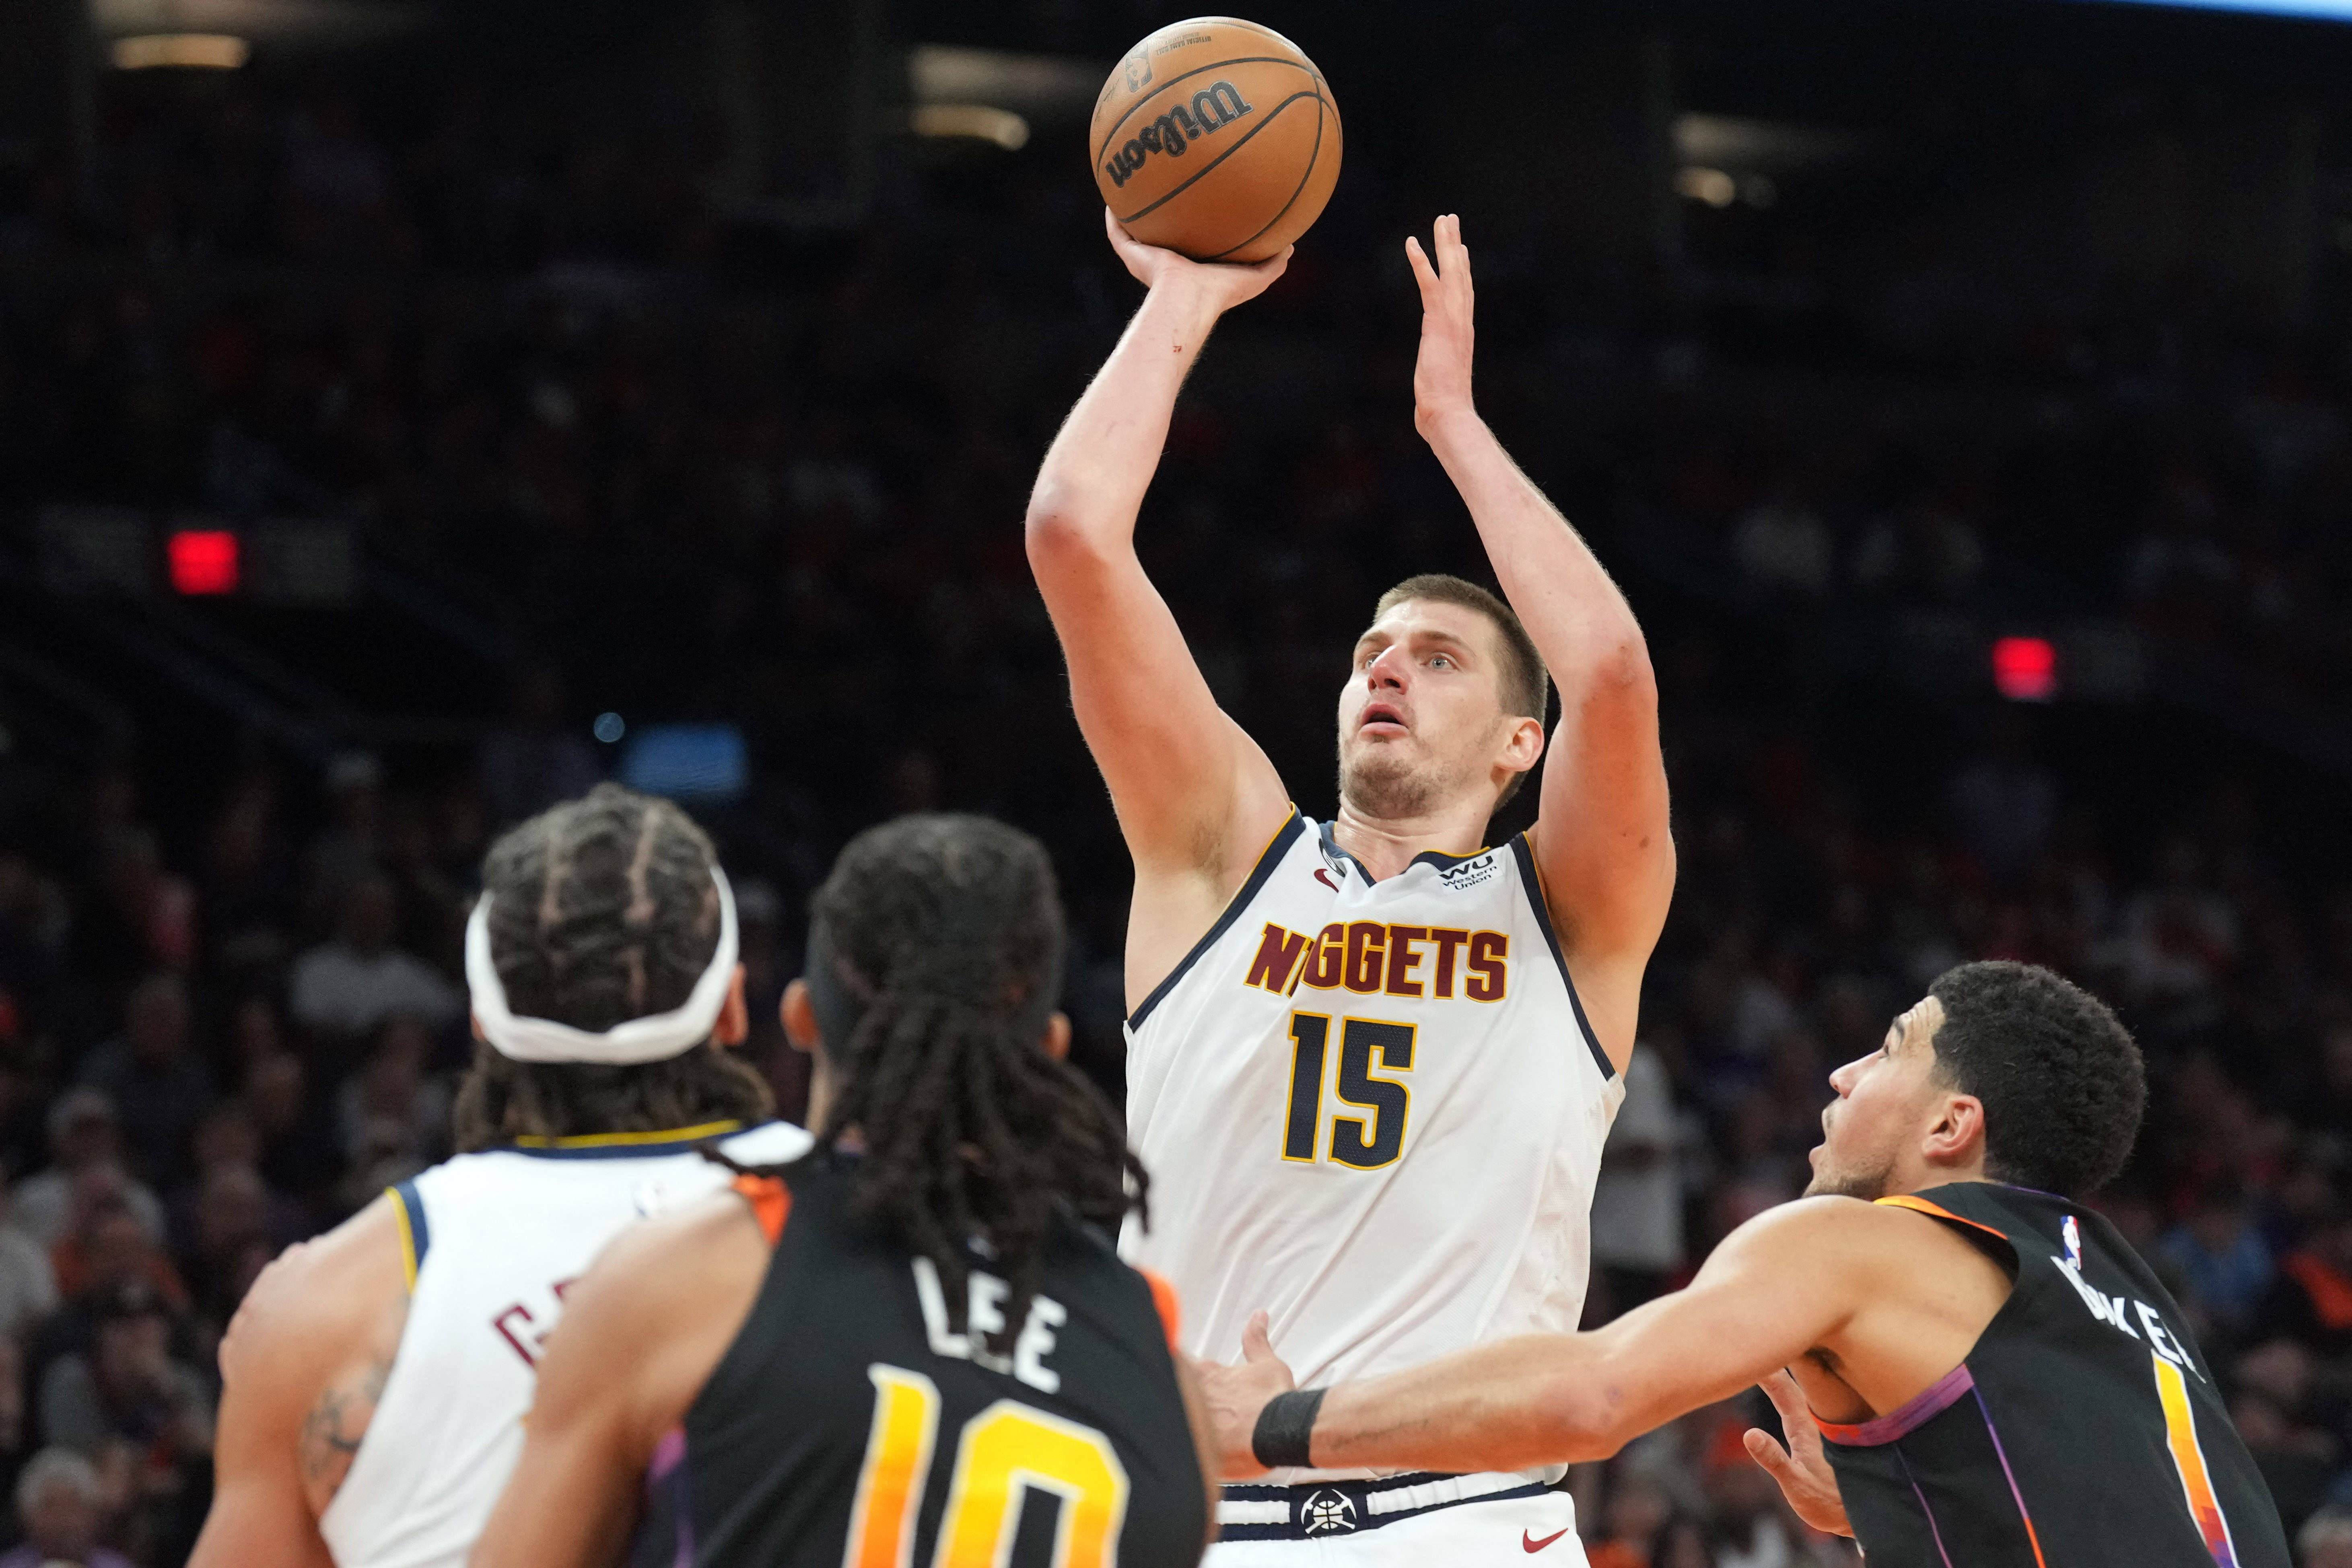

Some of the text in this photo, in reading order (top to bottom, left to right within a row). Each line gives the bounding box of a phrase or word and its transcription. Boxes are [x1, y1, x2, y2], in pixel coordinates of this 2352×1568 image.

[1105, 80, 1254, 188] Wilson
[1439, 855, 1493, 880] WU
[1442, 866, 1497, 886] Western
[1454, 874, 1491, 890] Union
[1281, 1010, 1418, 1171] 15
[910, 1254, 1067, 1395] LEE
[841, 1362, 1131, 1568] 10
